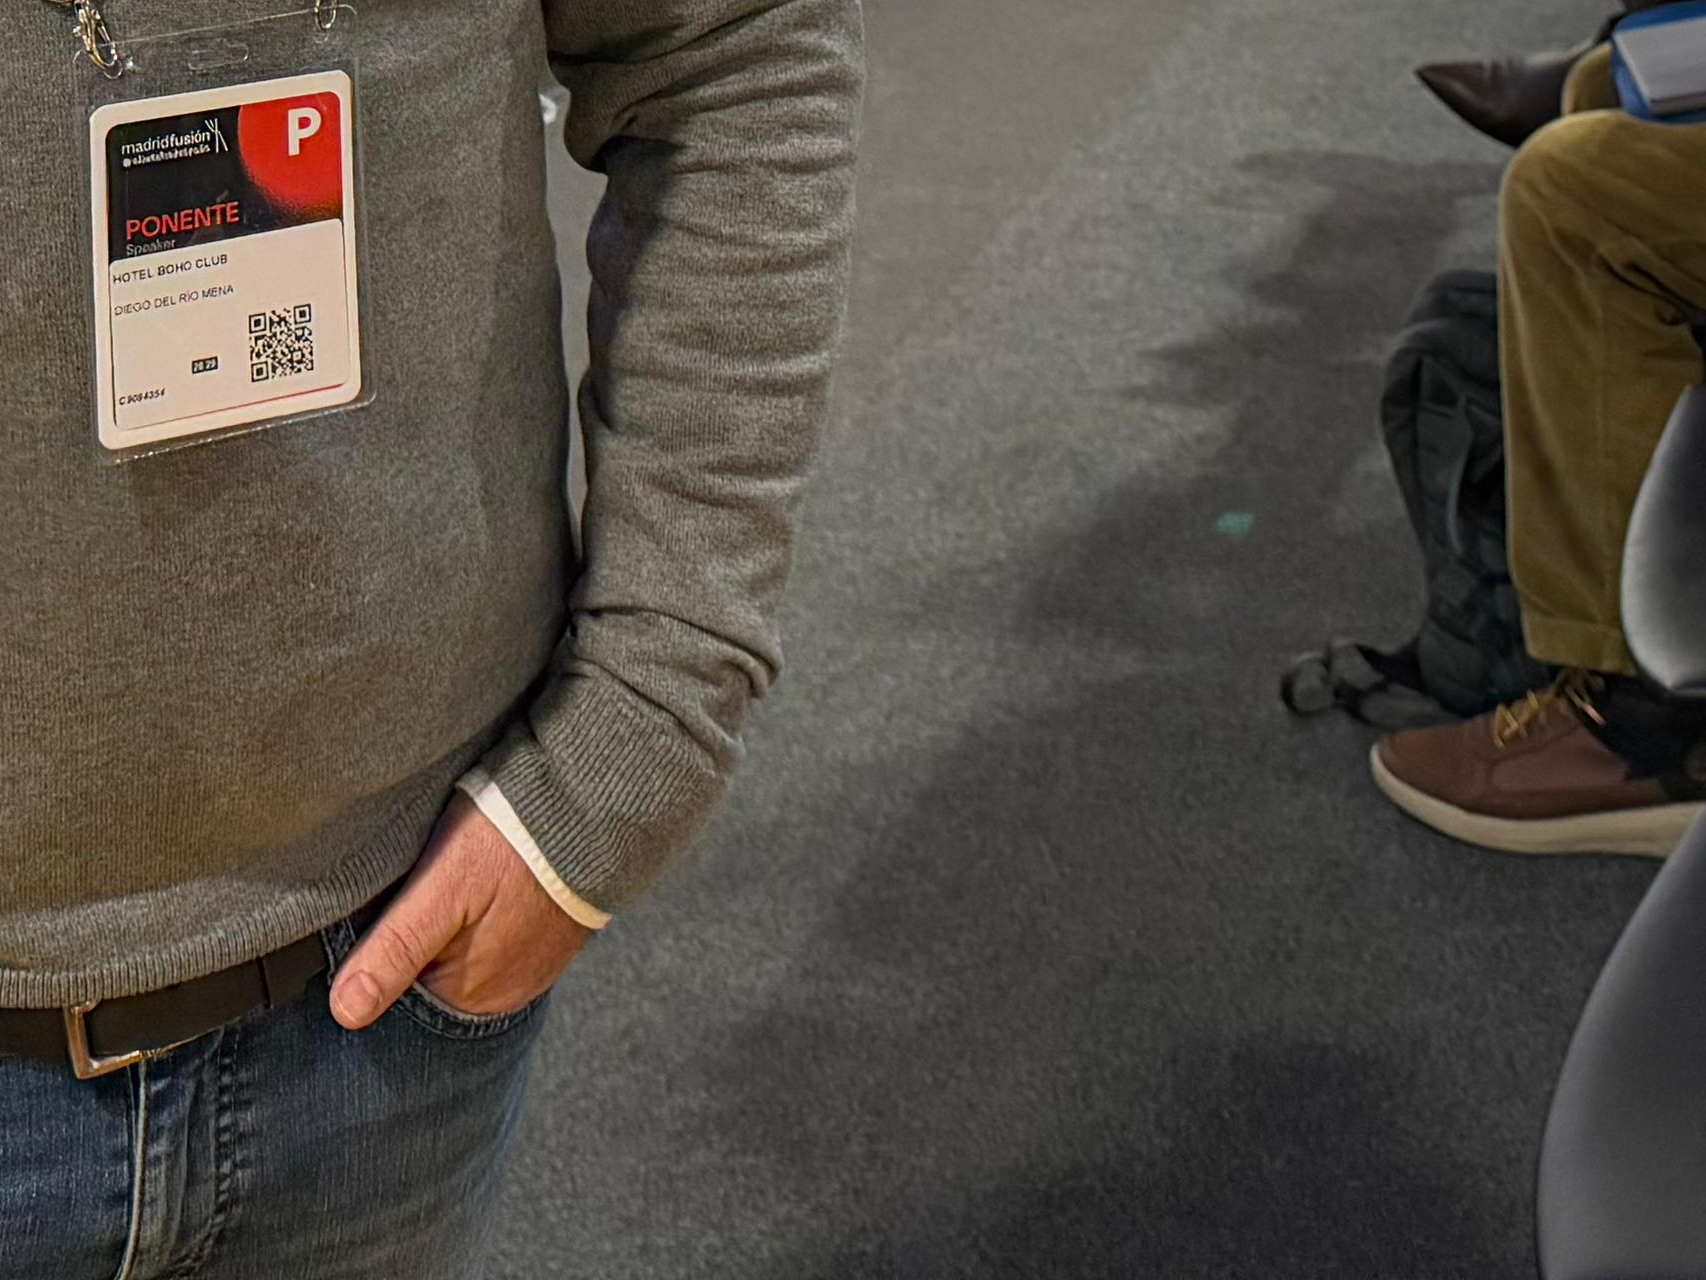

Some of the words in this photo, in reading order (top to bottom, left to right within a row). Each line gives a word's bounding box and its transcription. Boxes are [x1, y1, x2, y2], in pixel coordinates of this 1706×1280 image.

[121, 129, 211, 156] madridfusión
[287, 107, 323, 157] P
[126, 200, 240, 241] PONENTE
[113, 268, 154, 285] HOTEL
[157, 261, 192, 277] BOHO
[195, 253, 228, 269] CLUB
[114, 300, 151, 316] DIEGO
[153, 294, 176, 309] DEL
[201, 284, 234, 299] MENA
